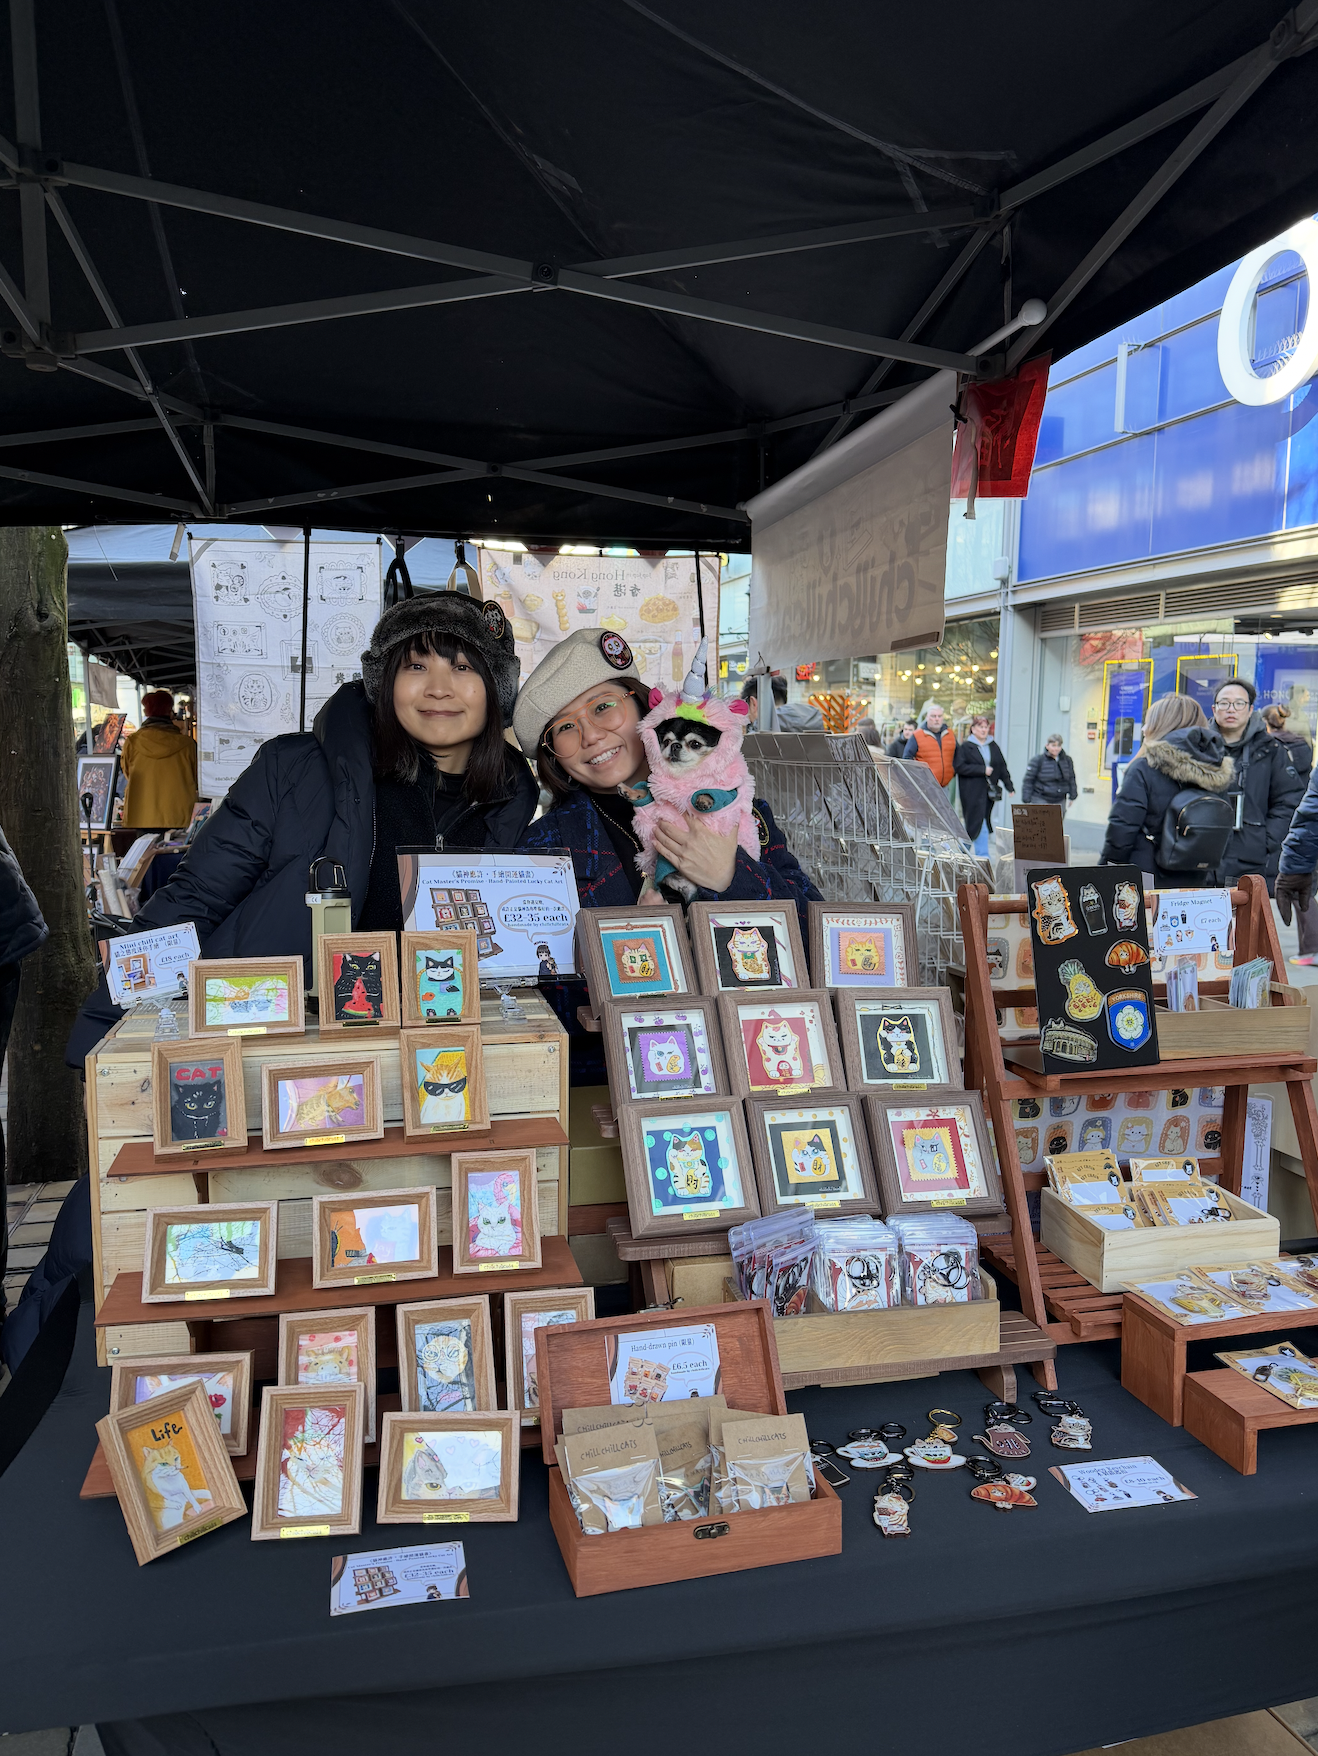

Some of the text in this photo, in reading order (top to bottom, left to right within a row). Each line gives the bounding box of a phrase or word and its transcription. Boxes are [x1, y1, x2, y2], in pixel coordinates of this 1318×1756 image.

[1190, 898, 1212, 906] Magnet
[504, 912, 568, 922] £32-35 each
[173, 952, 190, 960] each
[1112, 992, 1142, 1002] YORKSHIRE
[175, 1066, 222, 1082] CAT
[630, 1342, 667, 1352] Hand-drawn
[668, 1340, 678, 1350] pin
[672, 1360, 708, 1371] £6.5 each
[151, 1422, 182, 1442] Life
